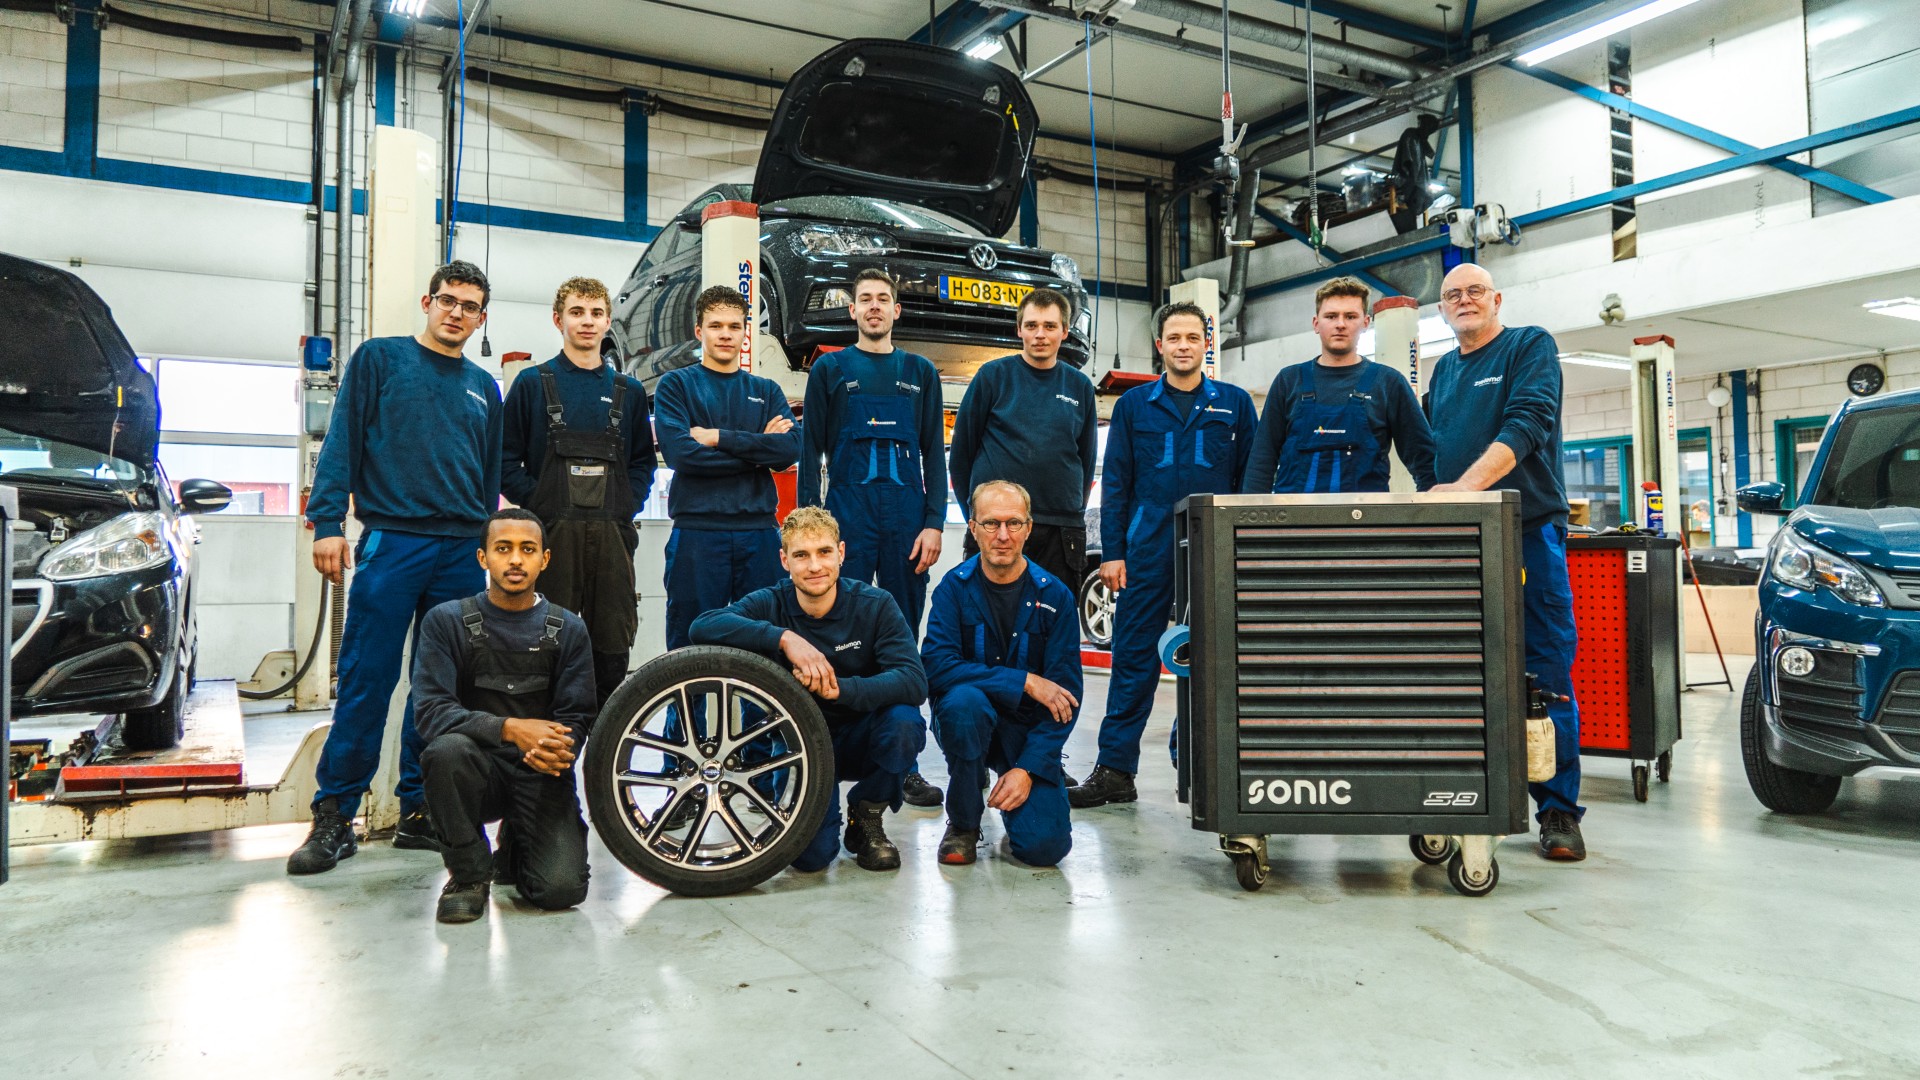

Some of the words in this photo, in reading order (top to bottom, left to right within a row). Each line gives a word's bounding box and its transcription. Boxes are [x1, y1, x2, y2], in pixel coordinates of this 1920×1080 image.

[738, 260, 752, 321] ster
[1409, 338, 1418, 384] stertil
[1249, 780, 1351, 805] SONIC
[1423, 792, 1478, 806] S9
